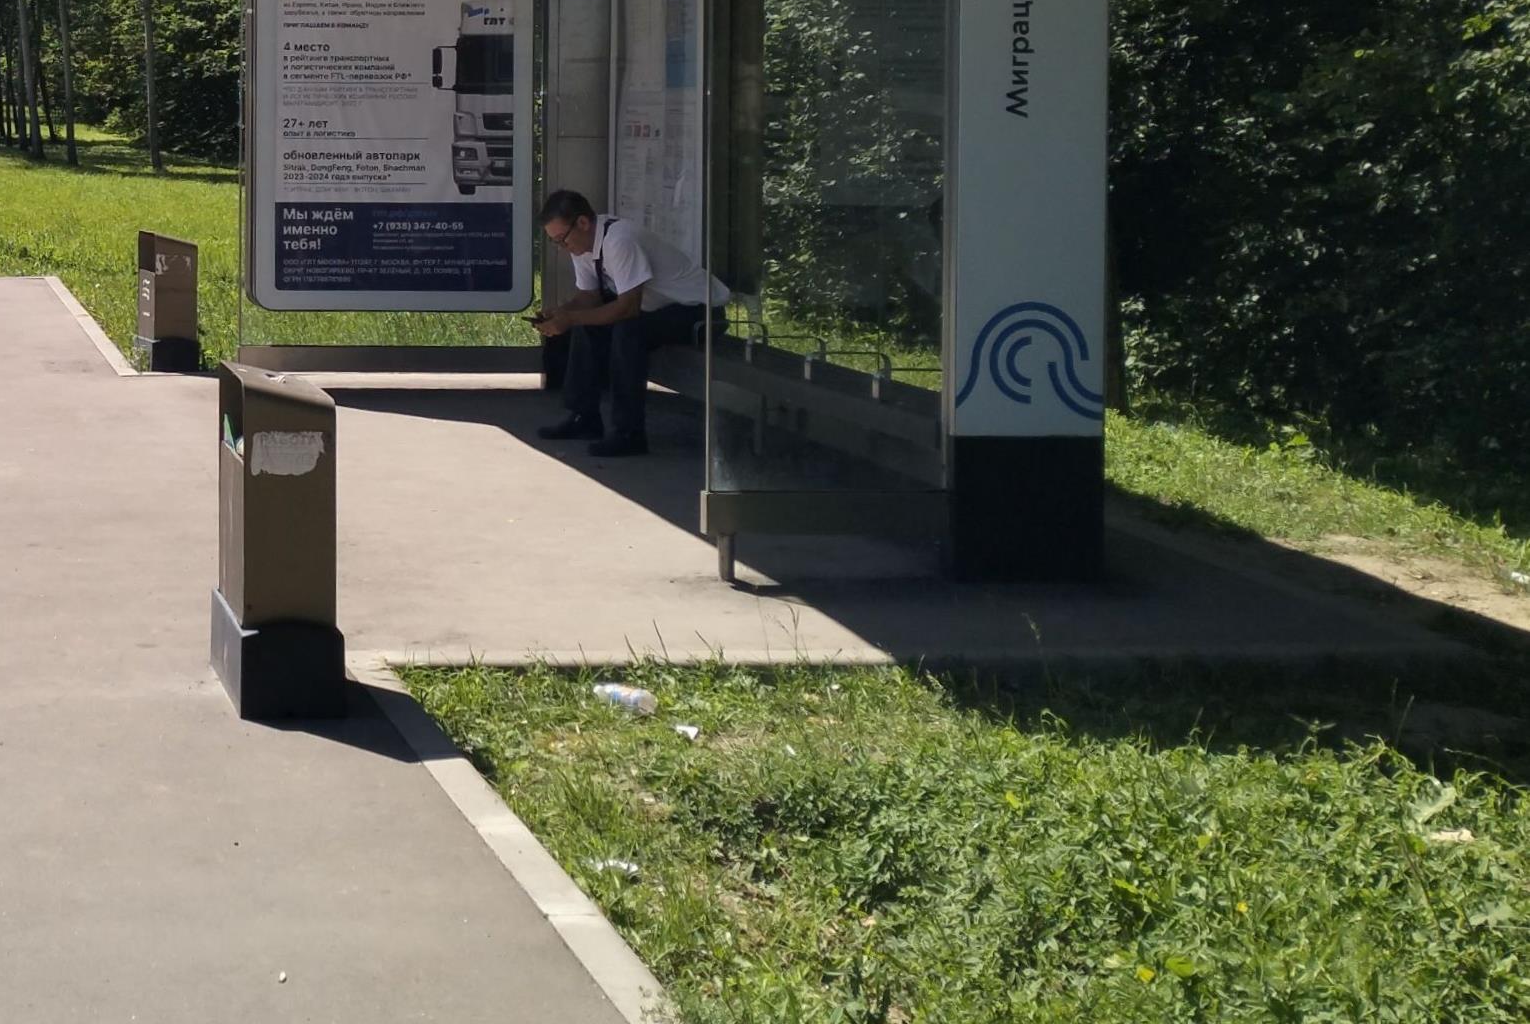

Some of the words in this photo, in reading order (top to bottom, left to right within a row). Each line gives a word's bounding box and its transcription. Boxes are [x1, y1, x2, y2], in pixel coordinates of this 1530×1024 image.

[484, 17, 506, 25] ГЛТ
[283, 42, 291, 50] 4
[294, 44, 330, 52] место
[290, 54, 328, 62] рейтинге
[283, 118, 305, 128] 27+
[308, 120, 328, 128] лет
[283, 150, 362, 160] обновленный
[365, 152, 420, 162] автопарк
[283, 208, 308, 220] Мы
[311, 207, 354, 221] ждём
[283, 225, 338, 235] именно
[373, 222, 384, 231] +7
[283, 238, 321, 250] тебя!
